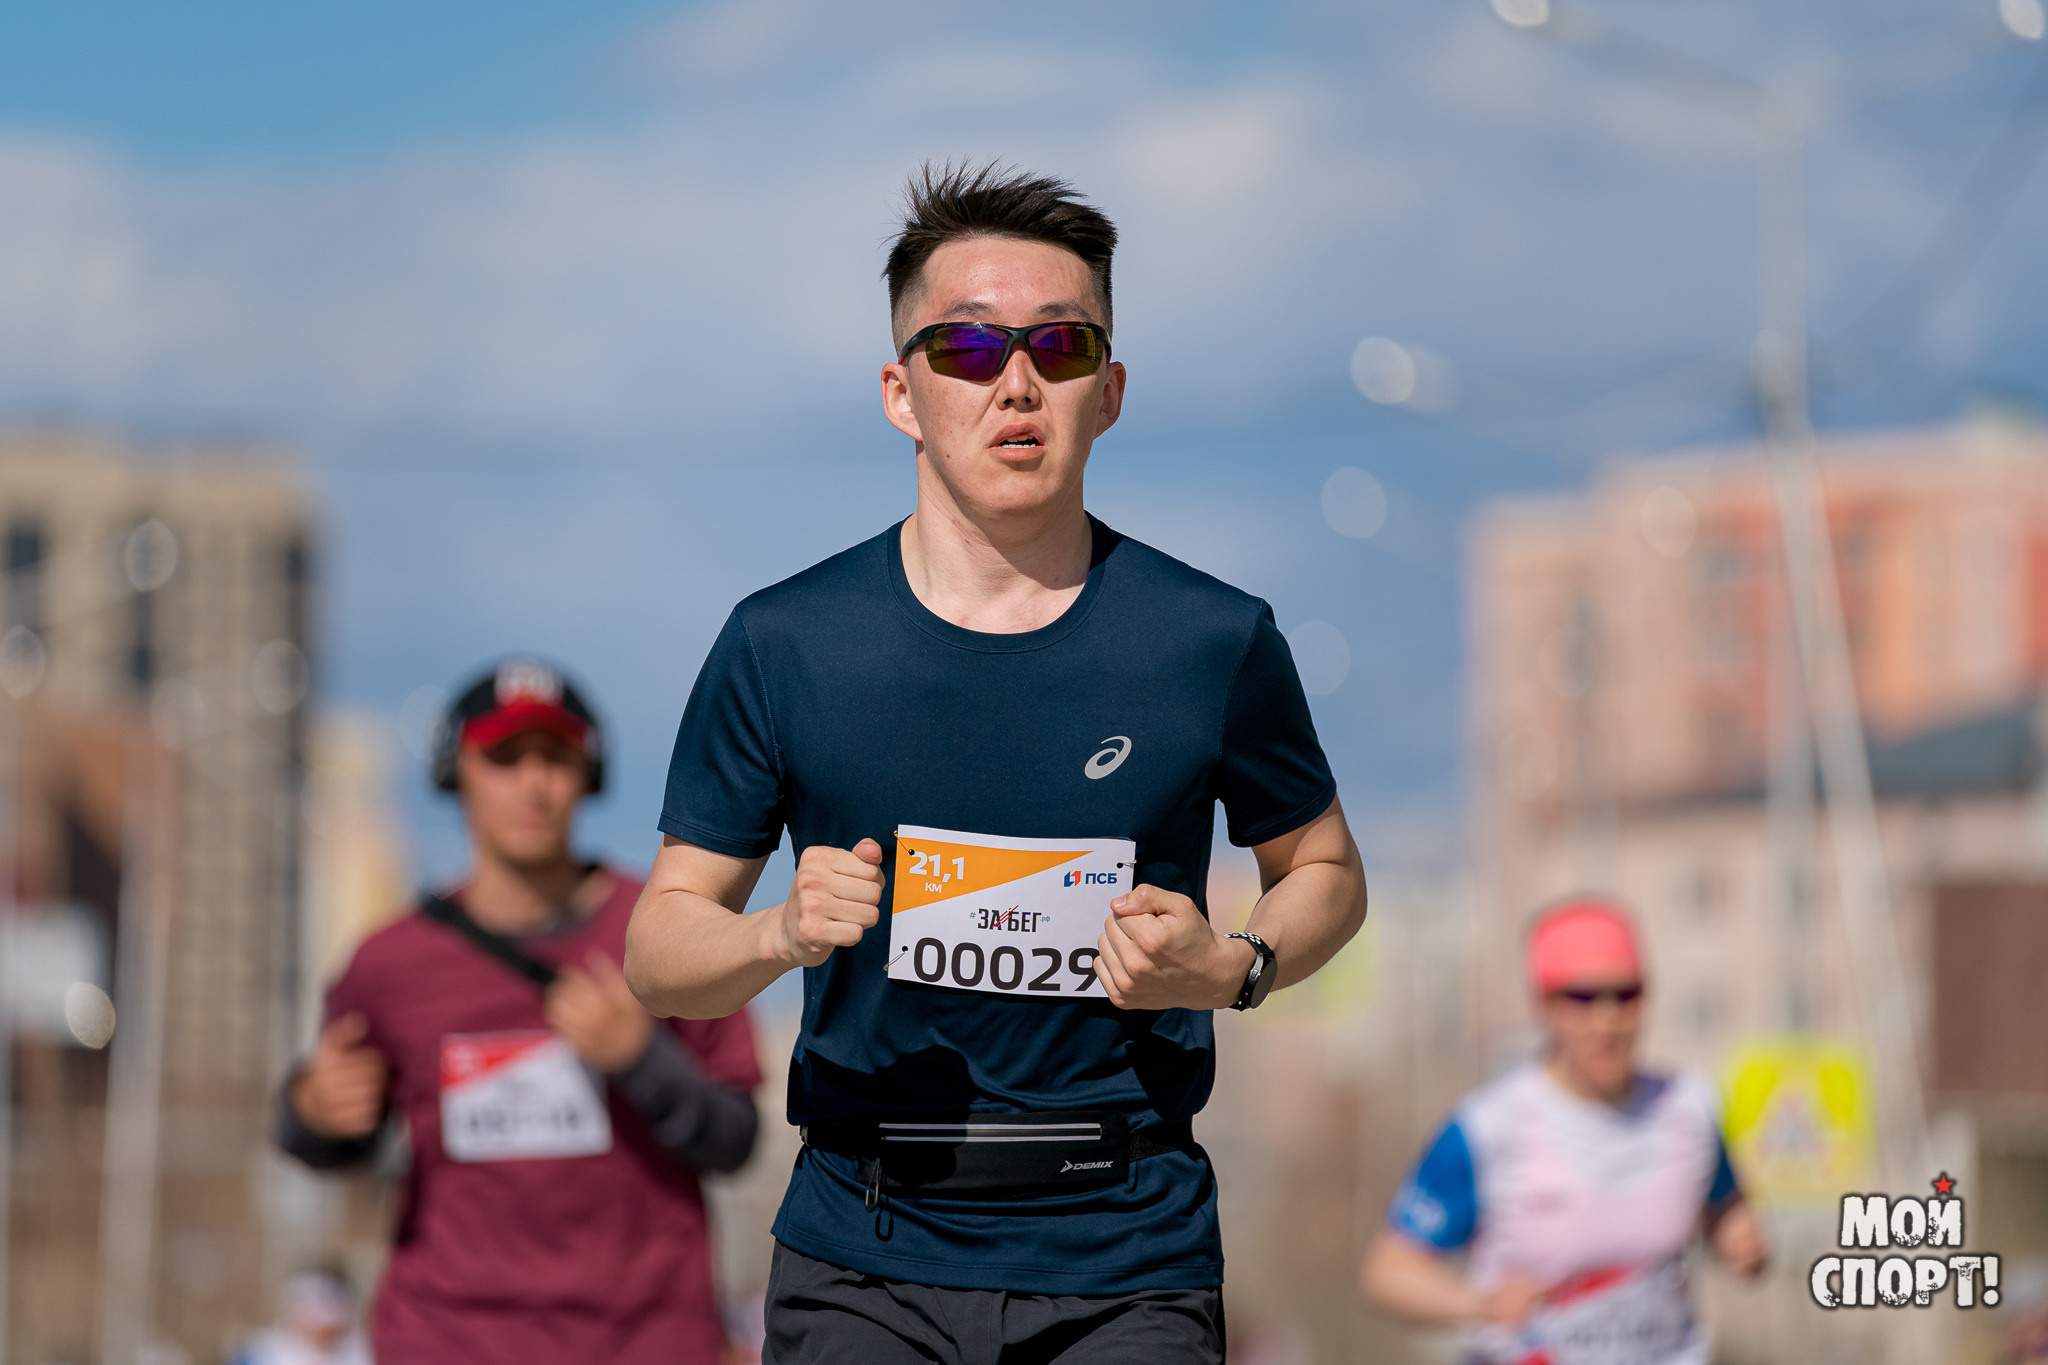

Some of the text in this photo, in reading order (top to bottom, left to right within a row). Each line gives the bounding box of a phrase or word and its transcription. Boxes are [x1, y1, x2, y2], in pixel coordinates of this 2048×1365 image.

[909, 851, 965, 883] 21,1
[1085, 872, 1118, 884] ПСБ
[914, 937, 1101, 992] 00029
[1072, 1160, 1114, 1171] DEMIX
